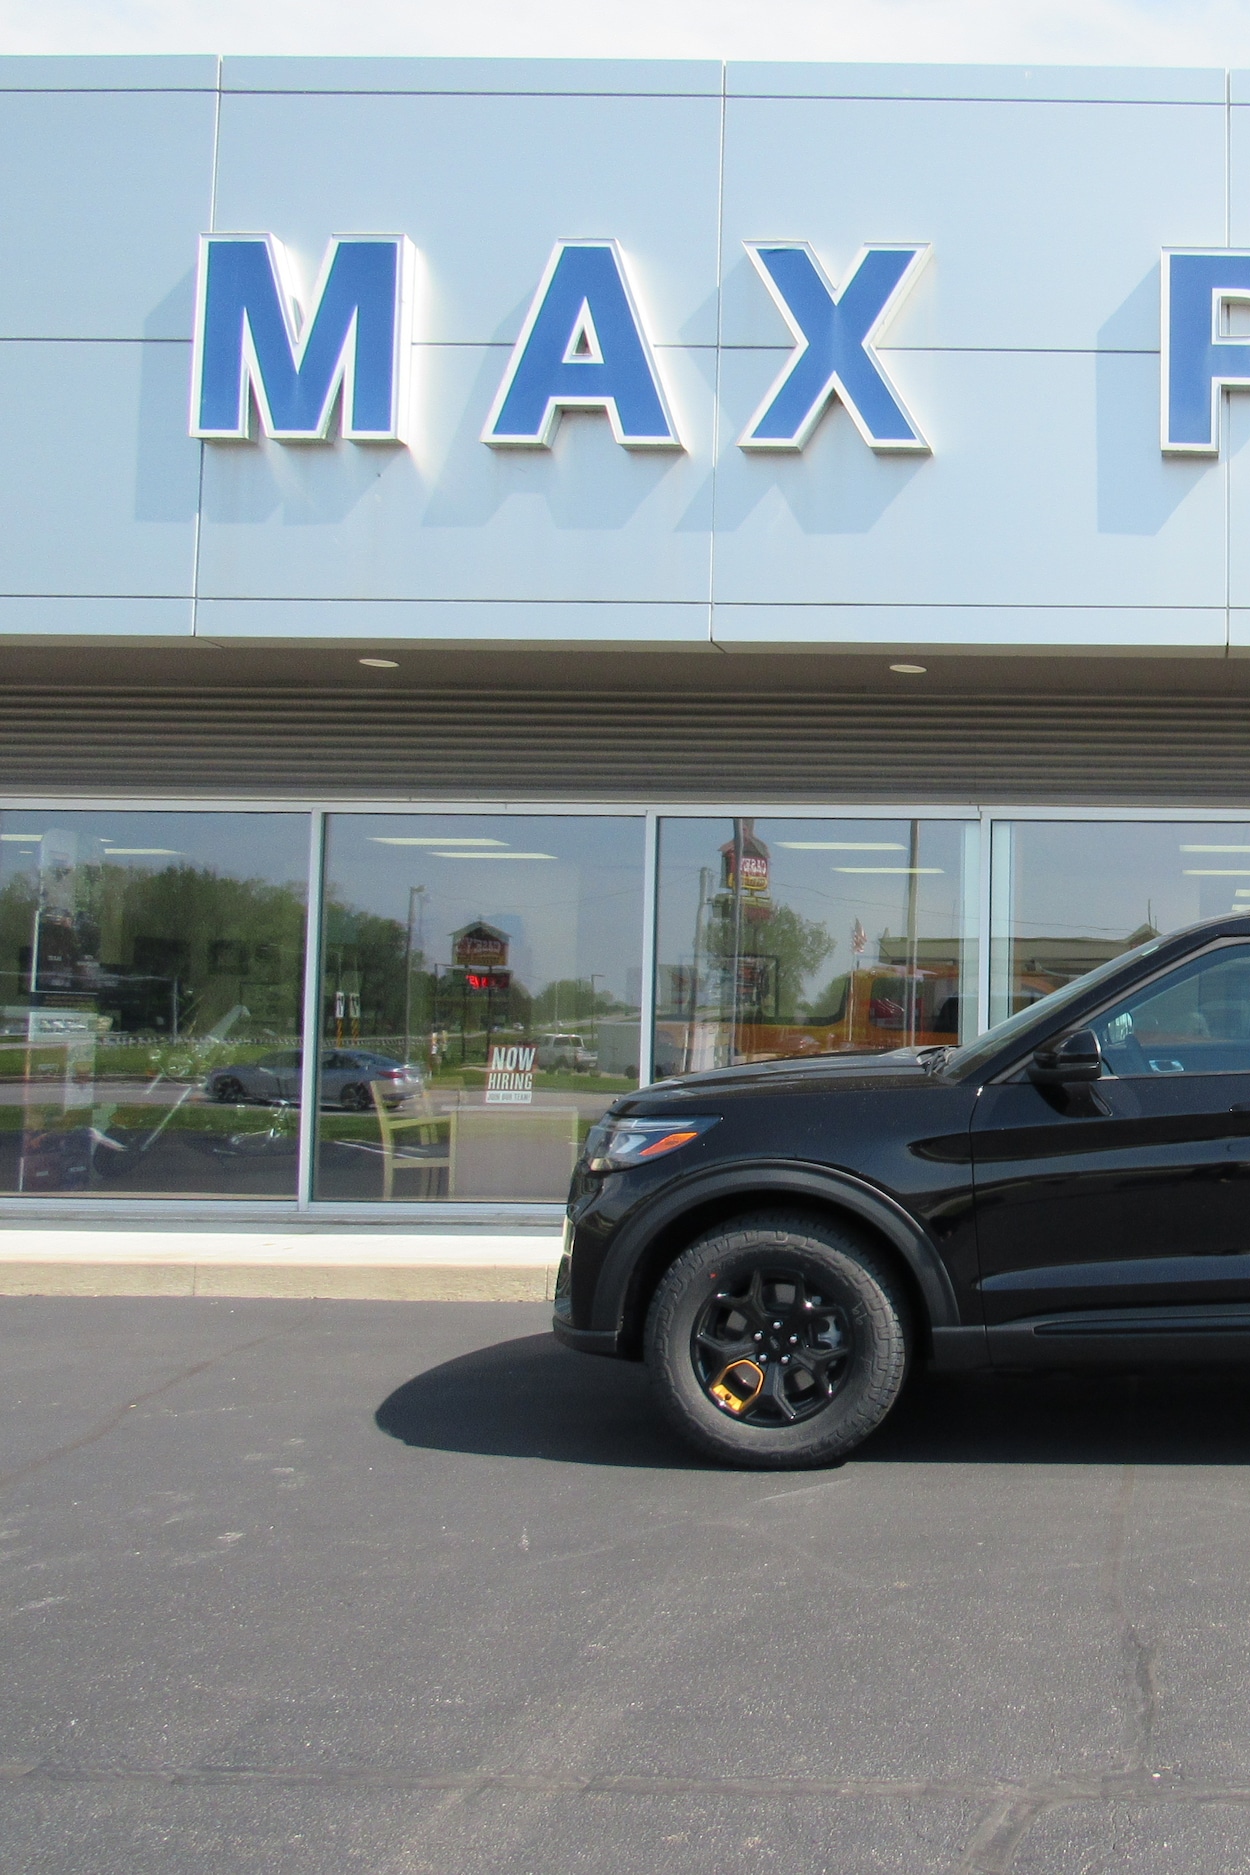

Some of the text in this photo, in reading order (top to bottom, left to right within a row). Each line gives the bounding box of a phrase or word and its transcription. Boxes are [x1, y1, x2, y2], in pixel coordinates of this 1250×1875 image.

[189, 232, 933, 455] MAX
[491, 1046, 536, 1071] NOW
[487, 1072, 533, 1090] HIRING
